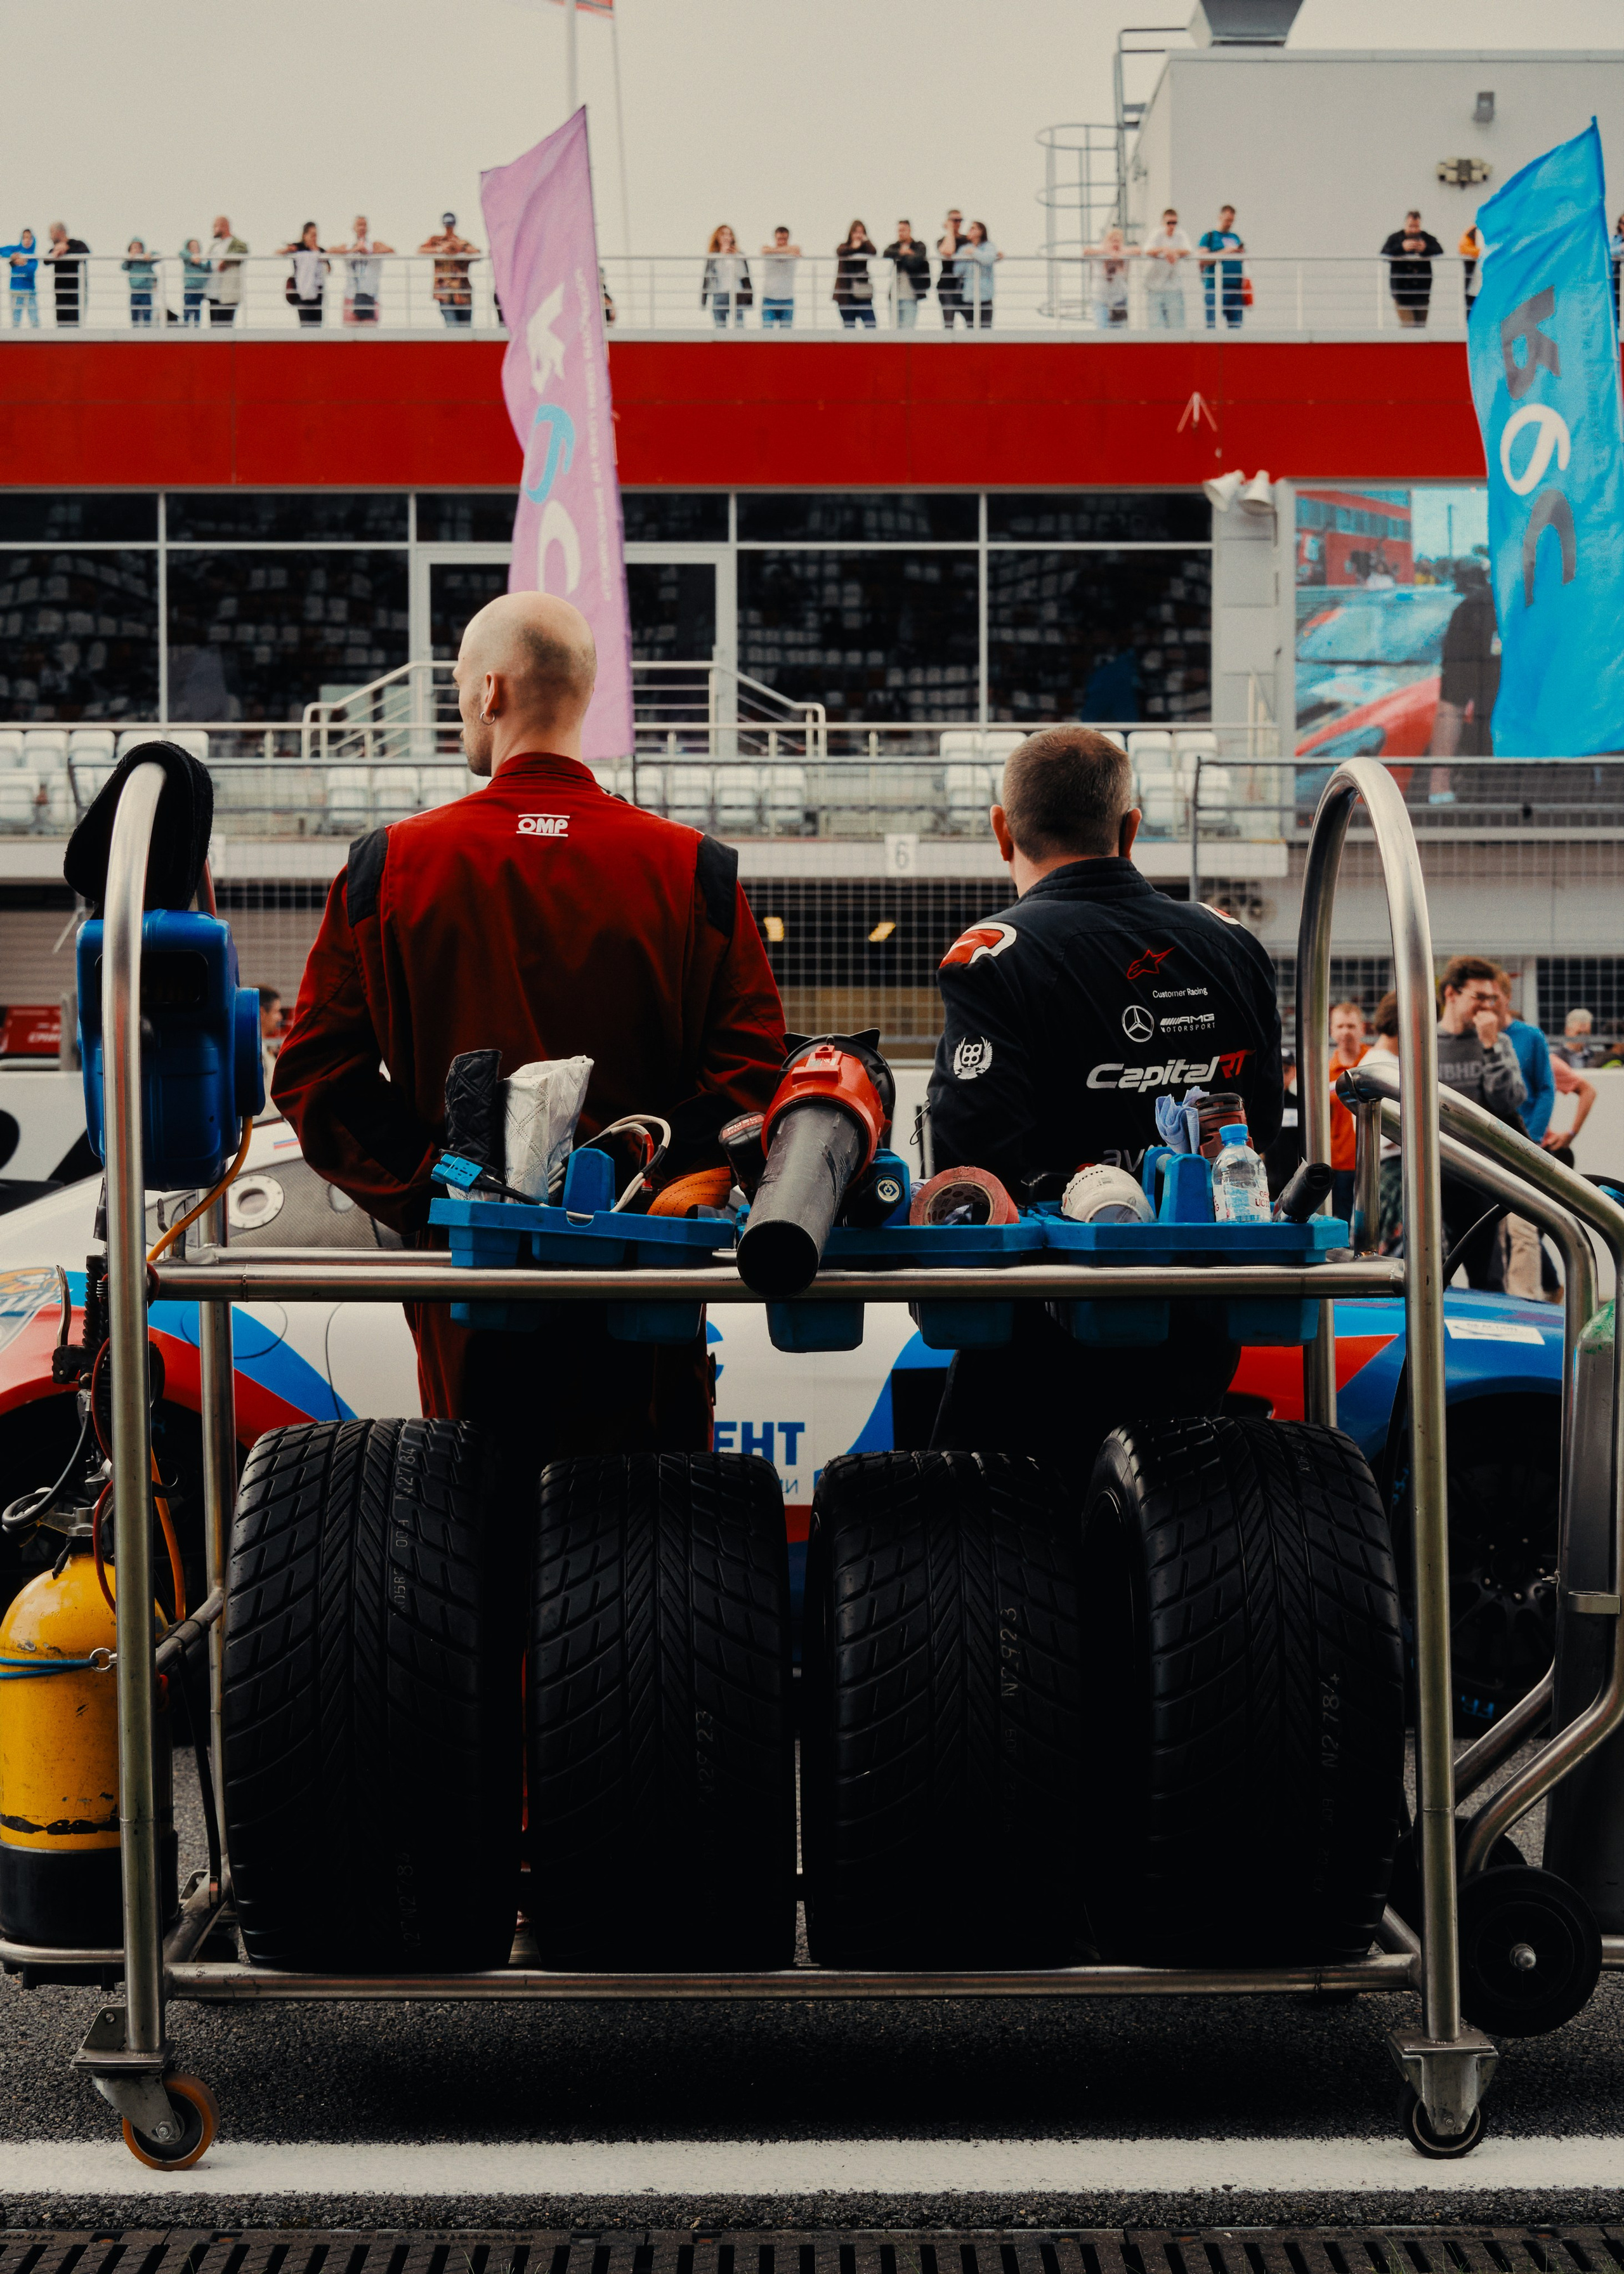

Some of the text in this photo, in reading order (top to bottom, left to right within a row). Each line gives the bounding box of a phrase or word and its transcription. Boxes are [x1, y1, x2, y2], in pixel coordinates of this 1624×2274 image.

[518, 817, 568, 835] OMP
[894, 841, 910, 870] 6
[1152, 987, 1208, 999] Customer Racing
[1177, 1013, 1215, 1024] AMG
[1160, 1022, 1215, 1033] MOTORSPORT
